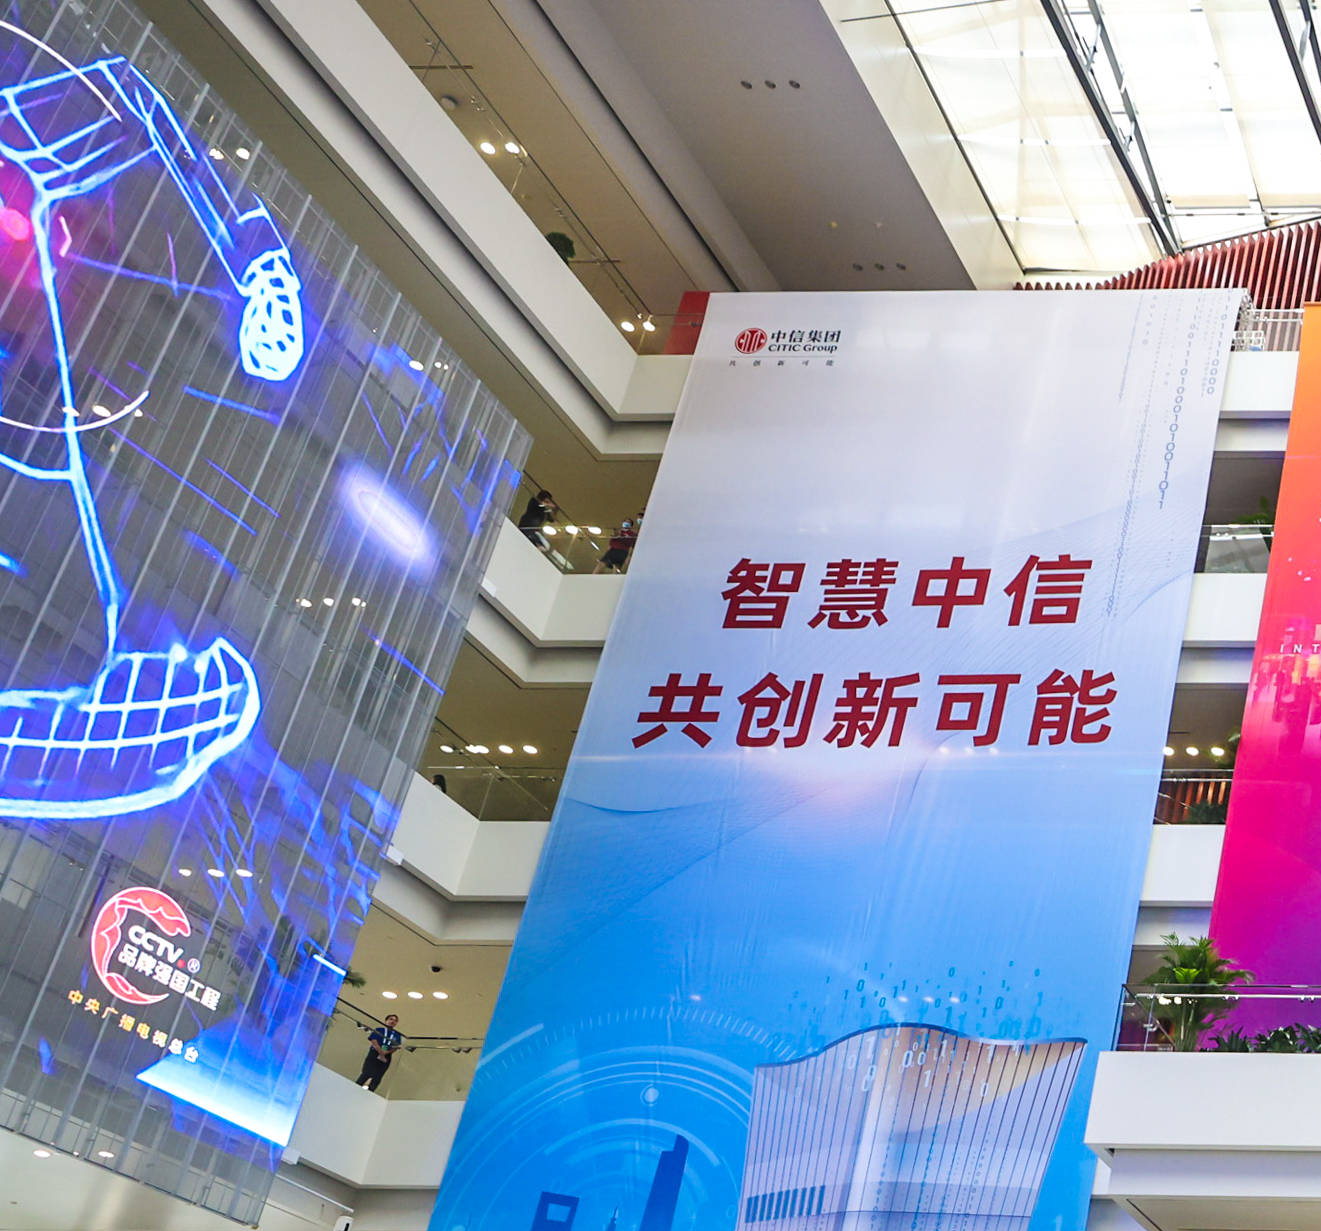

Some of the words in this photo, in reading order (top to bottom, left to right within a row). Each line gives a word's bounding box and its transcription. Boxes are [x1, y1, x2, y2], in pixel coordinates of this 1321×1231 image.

[768, 344, 800, 352] CITIC
[803, 345, 838, 354] Group
[770, 330, 841, 343] 中信集团
[721, 554, 1093, 629] 智慧中信
[632, 669, 1118, 750] 共创新可能
[118, 943, 221, 1011] 品牌强国工程
[128, 925, 184, 963] CCTV
[68, 990, 199, 1063] 中央广播电视总台
